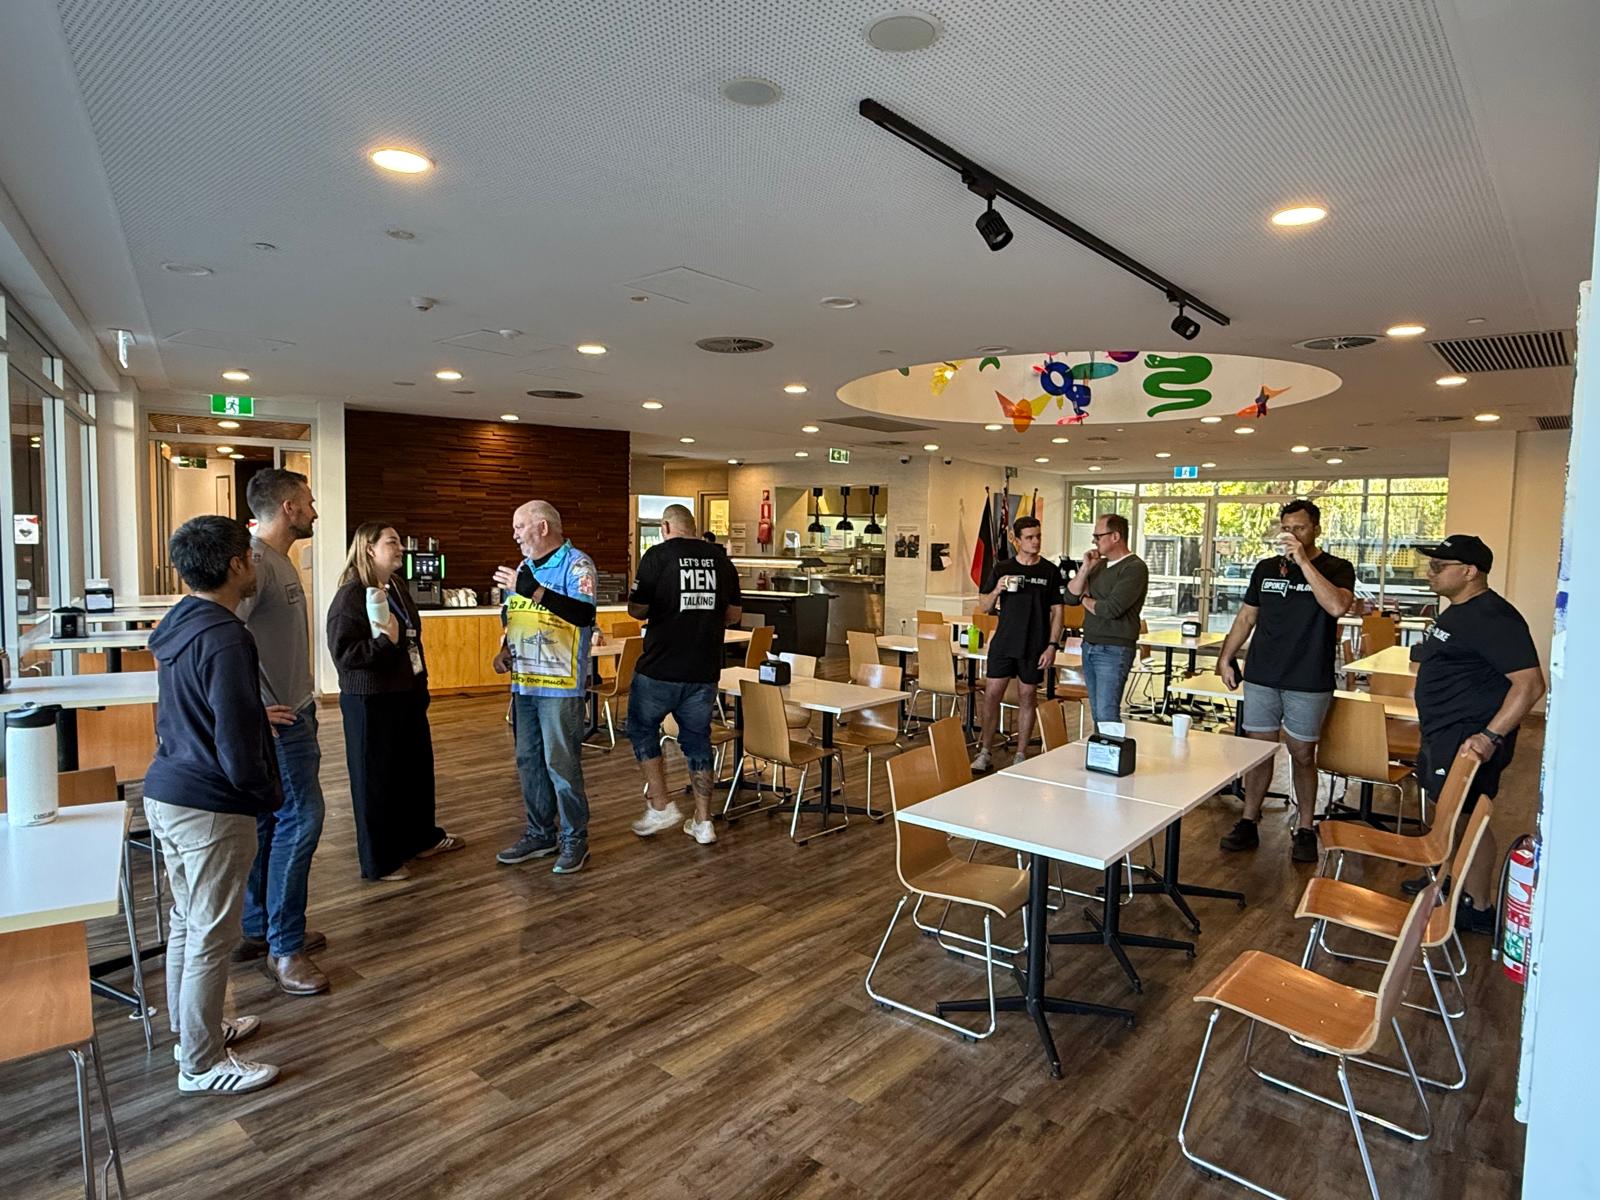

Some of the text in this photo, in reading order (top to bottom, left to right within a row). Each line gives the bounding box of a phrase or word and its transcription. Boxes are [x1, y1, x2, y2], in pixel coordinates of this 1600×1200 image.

[679, 558, 714, 567] LET'S GET
[680, 569, 716, 590] MEN
[1264, 581, 1287, 590] SPOKE
[683, 596, 714, 606] TALKING
